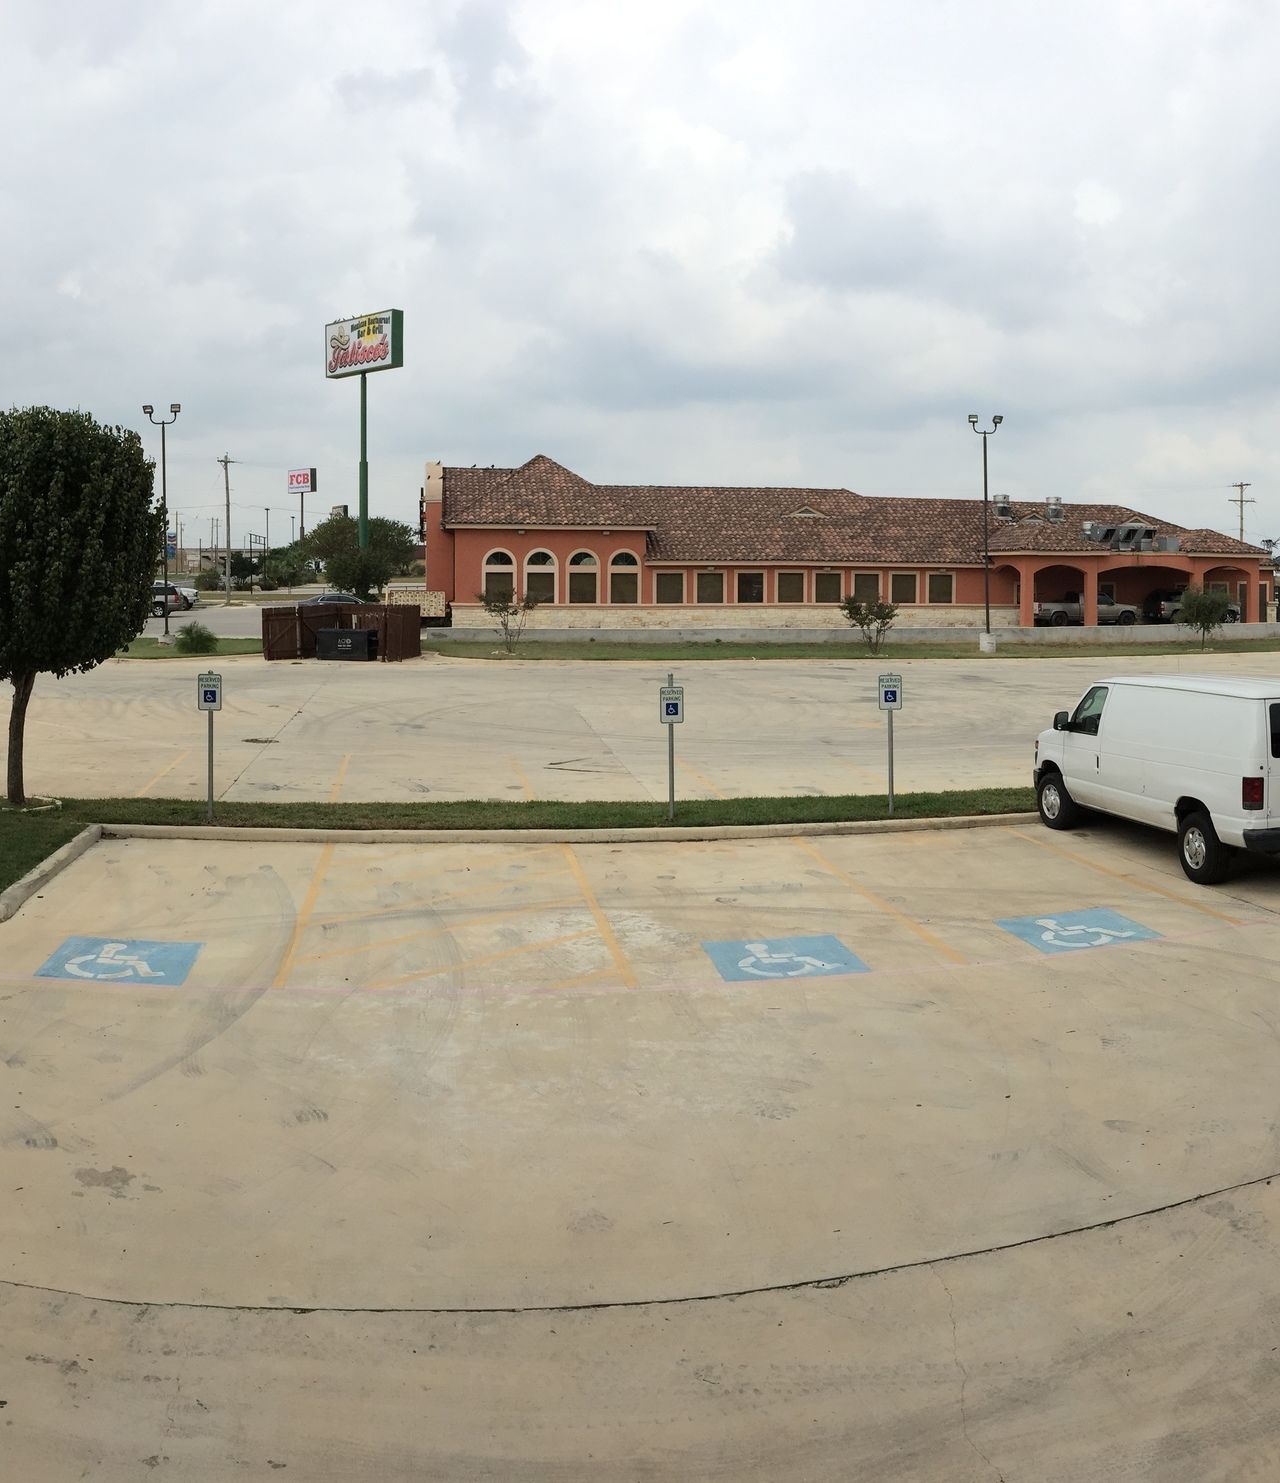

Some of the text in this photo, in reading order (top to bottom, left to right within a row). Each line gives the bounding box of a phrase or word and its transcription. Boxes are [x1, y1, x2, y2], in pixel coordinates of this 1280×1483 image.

[357, 328, 366, 339] Bar
[372, 324, 384, 335] Grill
[289, 473, 310, 485] FCB
